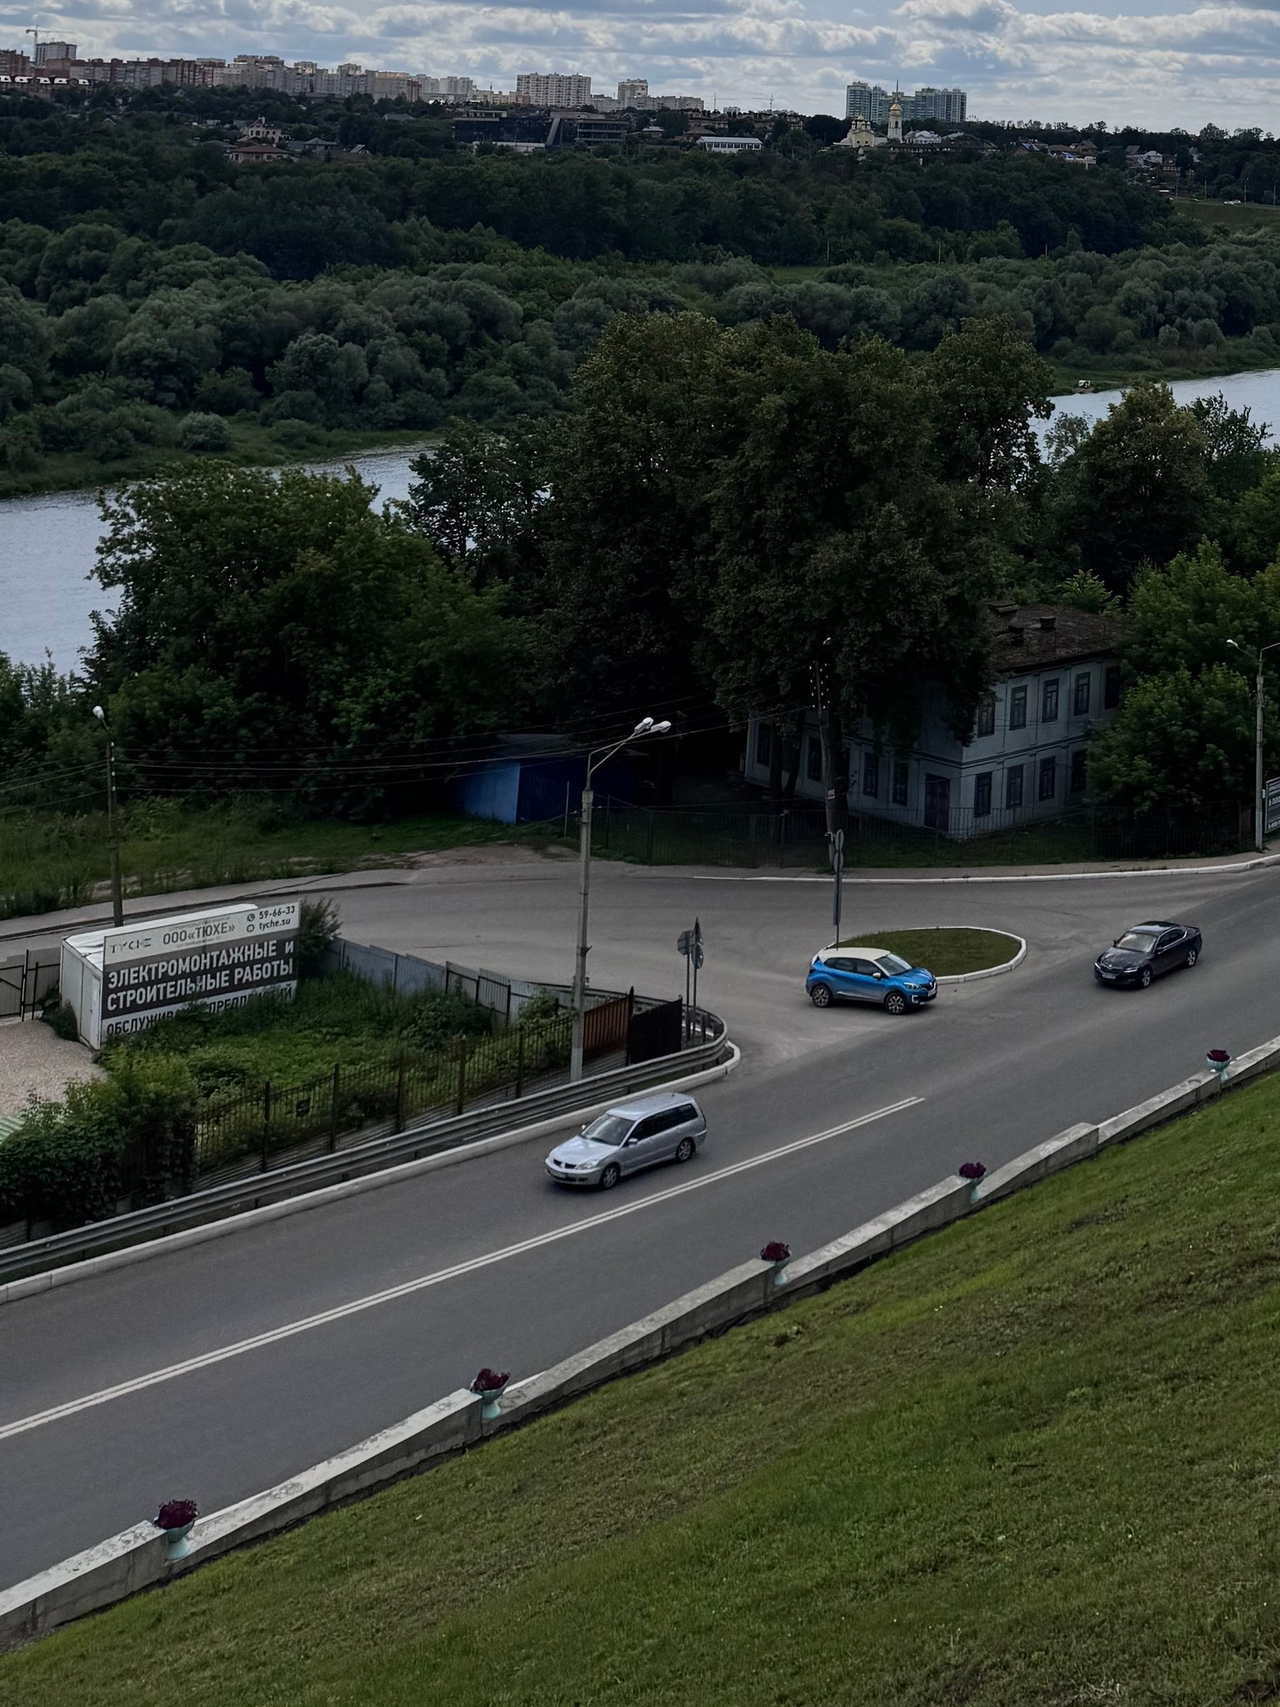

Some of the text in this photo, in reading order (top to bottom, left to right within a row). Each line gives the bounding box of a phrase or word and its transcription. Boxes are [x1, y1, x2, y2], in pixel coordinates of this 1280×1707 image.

[259, 905, 295, 920] 59-66-33
[259, 918, 291, 931] tyche.su
[108, 940, 277, 989] ЭЛЕКТРОМОНТАЖНЫЕ
[107, 958, 293, 1011] СТРОИТЕЛЬНЫЕ РАБОТЫ
